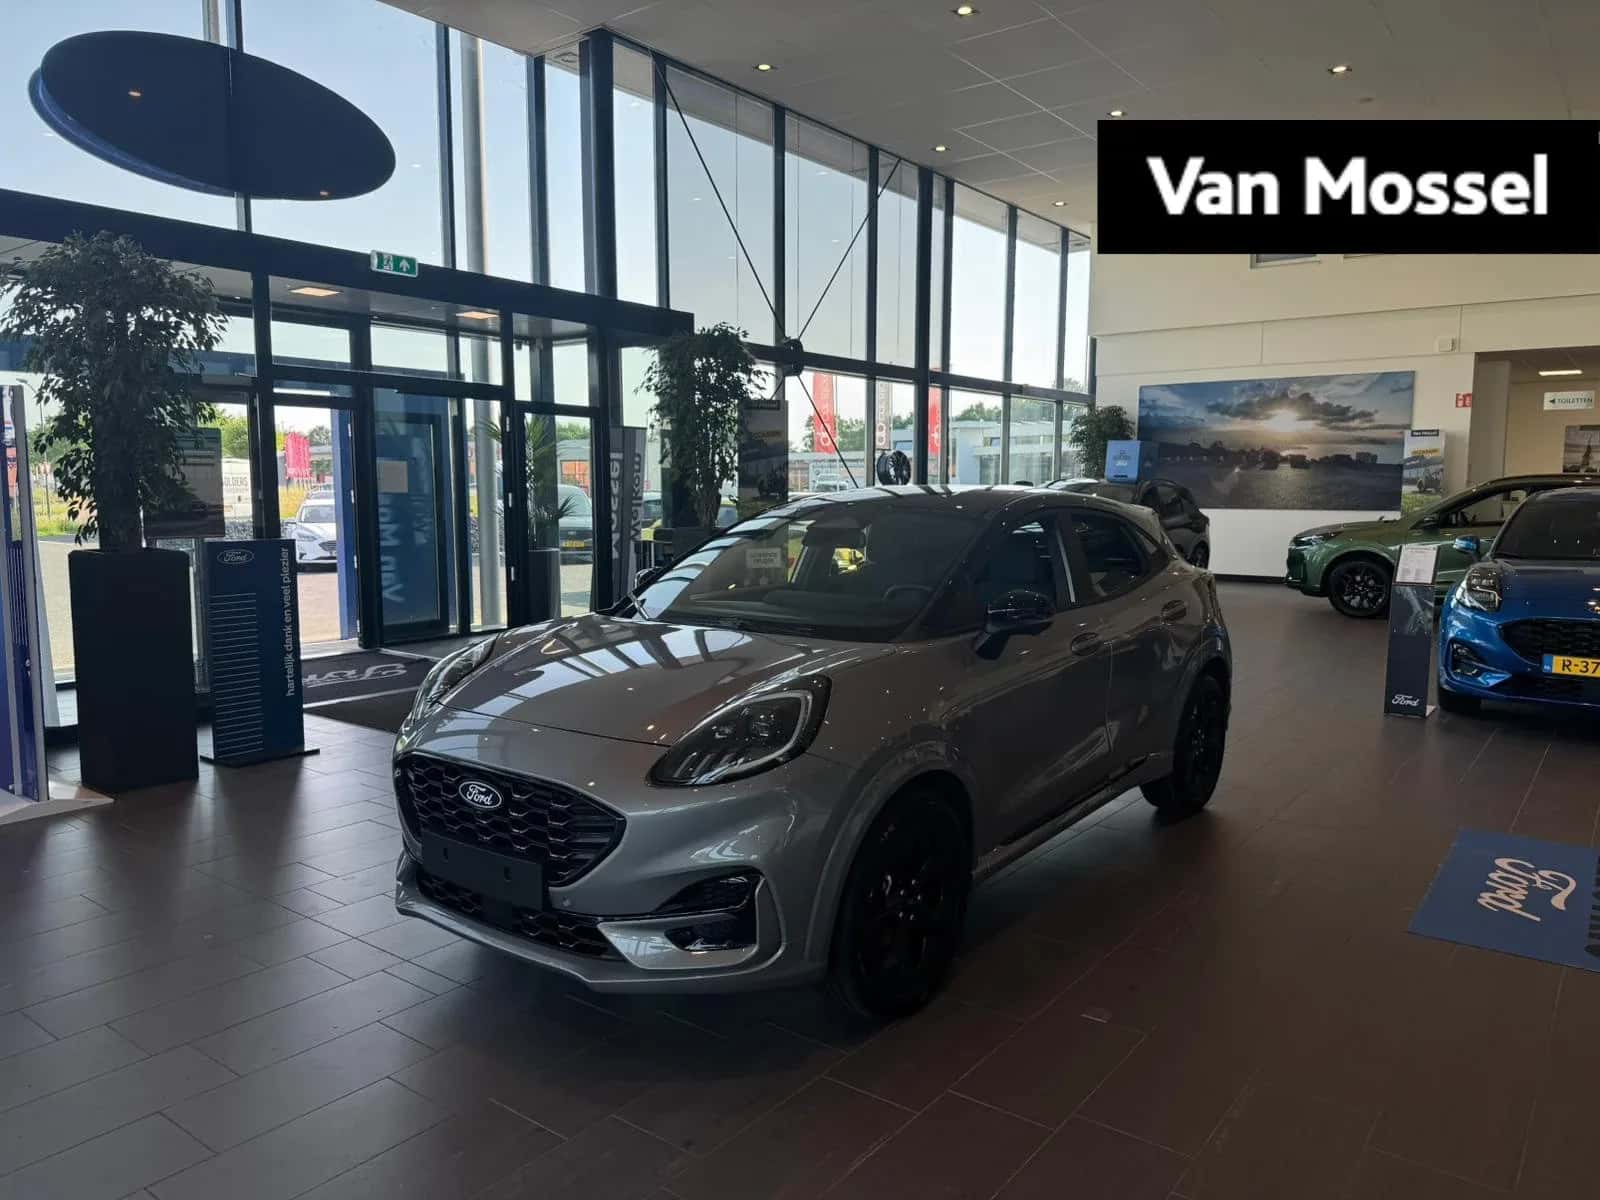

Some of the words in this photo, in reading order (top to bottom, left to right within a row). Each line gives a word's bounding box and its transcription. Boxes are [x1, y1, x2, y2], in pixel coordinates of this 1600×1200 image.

[279, 547, 291, 584] plezier
[281, 585, 291, 607] veel
[283, 608, 292, 623] en
[282, 624, 294, 652] dank
[284, 652, 296, 697] hartelijk
[1391, 693, 1421, 707] Ford
[465, 783, 493, 806] Ford
[1476, 856, 1577, 923] Ford
